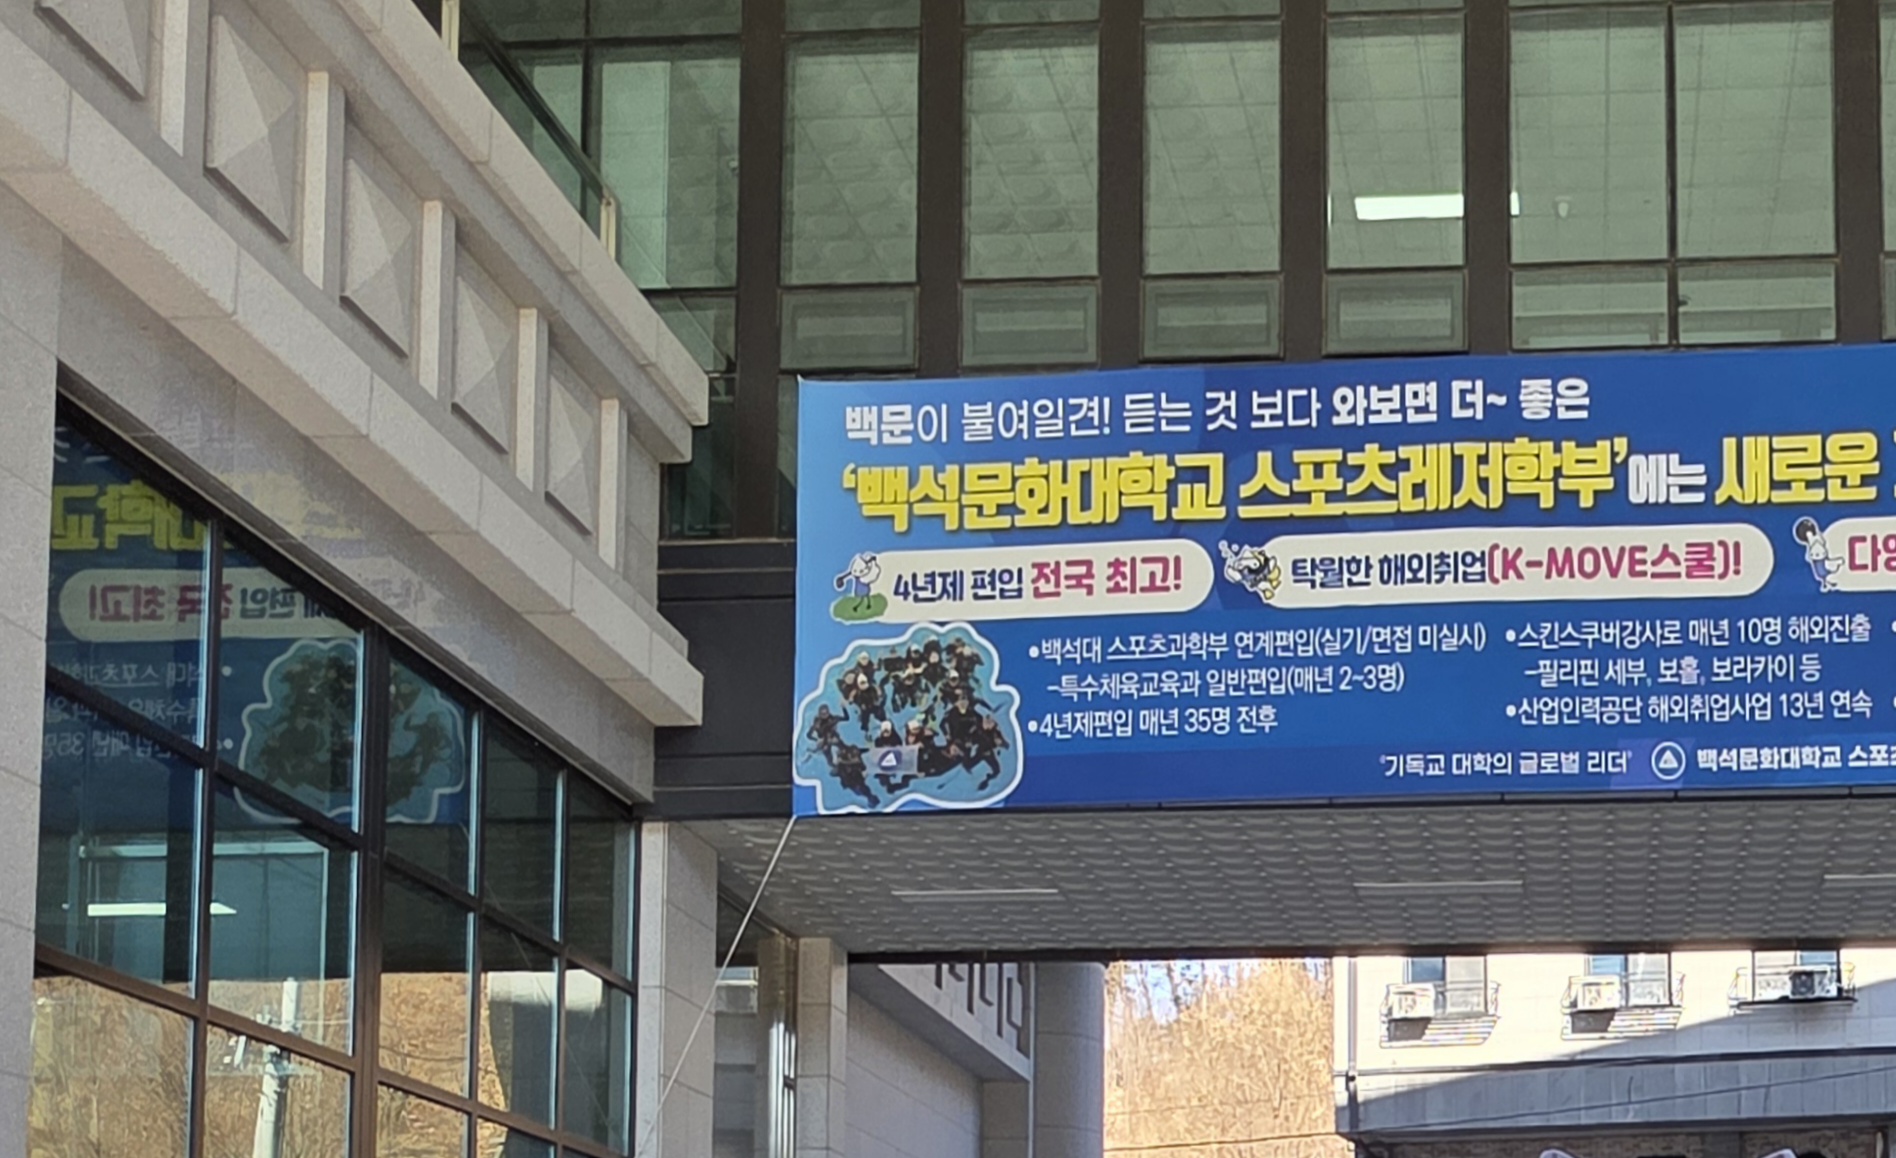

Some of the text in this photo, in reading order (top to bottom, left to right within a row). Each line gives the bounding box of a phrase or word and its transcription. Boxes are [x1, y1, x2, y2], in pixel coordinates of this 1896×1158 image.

[845, 377, 1590, 446] 백문이 불여일견! 듣는 것 보다 와보면 더~ 좋은
[1714, 431, 1880, 505] 새로운
[892, 555, 1183, 604] 4년제 편입 전국 최고!
[1291, 555, 1373, 590] 탁월한
[1041, 635, 1102, 666] 백석대
[1107, 631, 1229, 662] 스포츠과학부
[1418, 622, 1486, 652] 미실시)
[1517, 612, 1872, 650] 스킨스쿠버강사로 매년 10명 해외진출
[1338, 662, 1405, 693] 2~3명)
[1603, 656, 1652, 688] 세부,
[1710, 653, 1795, 685] 보라카이
[1799, 652, 1823, 684] 등
[1039, 703, 1278, 738] 4년제편입 매년 35명 전후
[1517, 688, 1873, 727] 산업인력공단 해외취업사업 13년 연속
[1450, 751, 1512, 776] 대학의
[1518, 750, 1580, 775] 글로벌
[1697, 745, 1841, 772] 백석문화대학교
